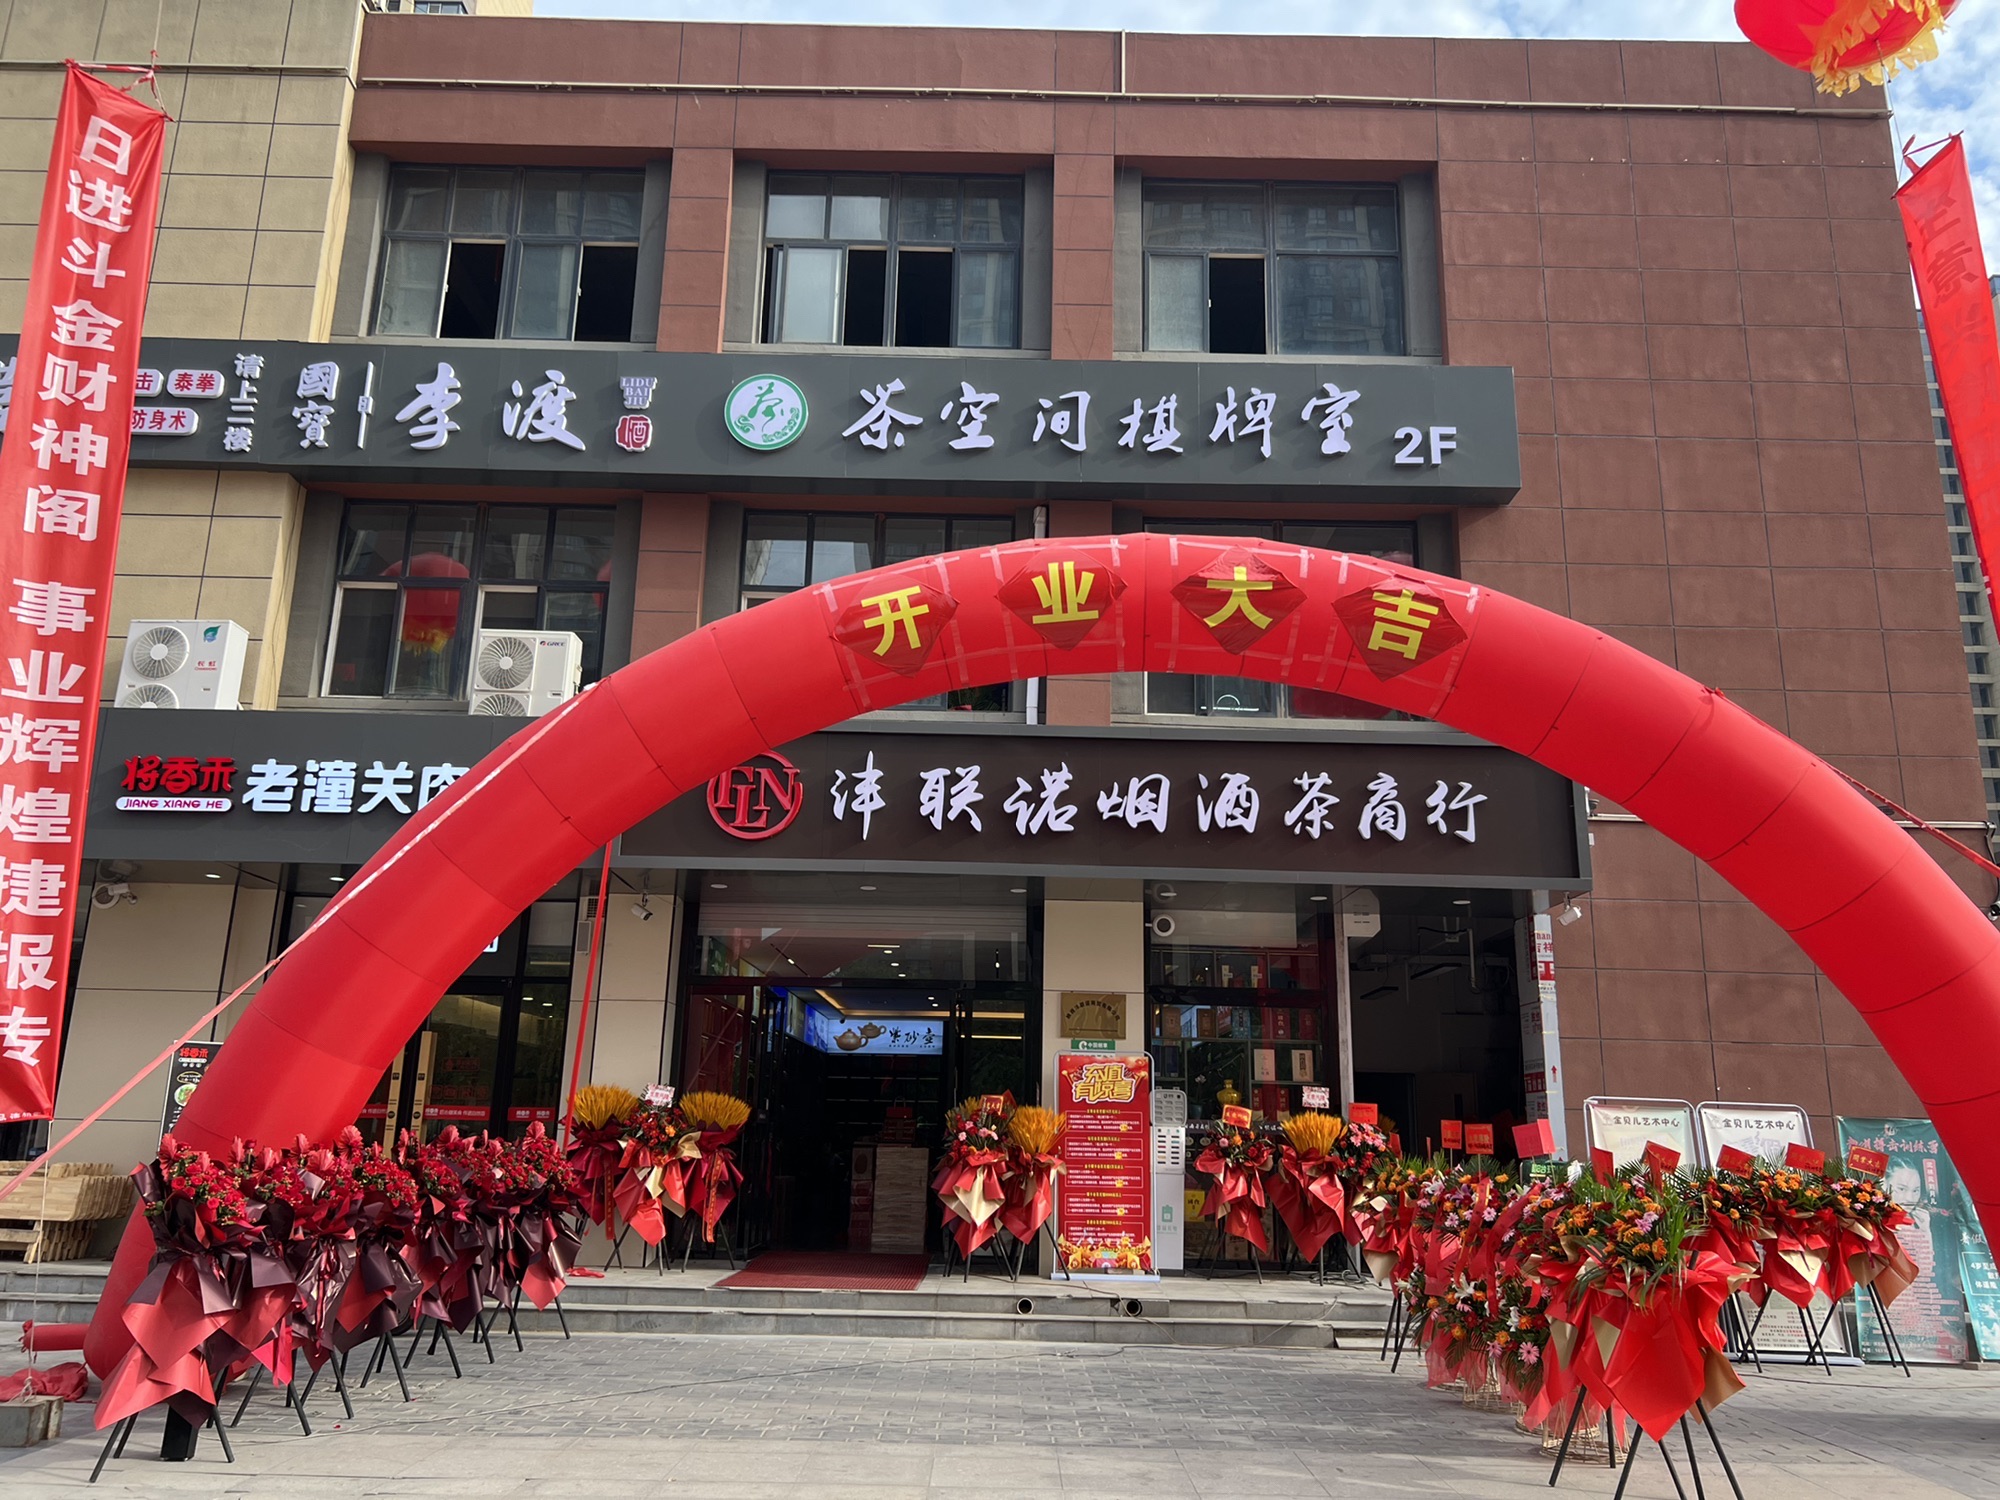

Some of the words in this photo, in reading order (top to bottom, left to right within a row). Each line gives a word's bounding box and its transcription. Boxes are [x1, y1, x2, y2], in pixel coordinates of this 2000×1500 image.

[24, 114, 132, 541] 日进斗金财神阁
[174, 373, 216, 392] 泰拳
[622, 377, 655, 387] LIDU
[625, 387, 649, 396] BAI
[224, 353, 264, 452] 请上二楼
[395, 362, 586, 451] 李渡
[624, 396, 648, 406] JIU
[131, 410, 187, 430] 防身术
[841, 377, 1361, 459] 茶空间棋牌室
[1393, 426, 1457, 467] 2F
[861, 560, 1439, 660] 开业大吉
[120, 755, 239, 794] 将香禾
[124, 799, 159, 808] JIANG
[163, 800, 201, 809] XIANG
[205, 801, 223, 809] HE
[889, 1026, 936, 1044] 紫砂壶
[1085, 1065, 1123, 1083] 充值
[1075, 1081, 1133, 1101] 有惊喜
[1613, 1115, 1680, 1128] 金贝儿艺术中心
[1722, 1117, 1796, 1131] 金贝儿艺术中心
